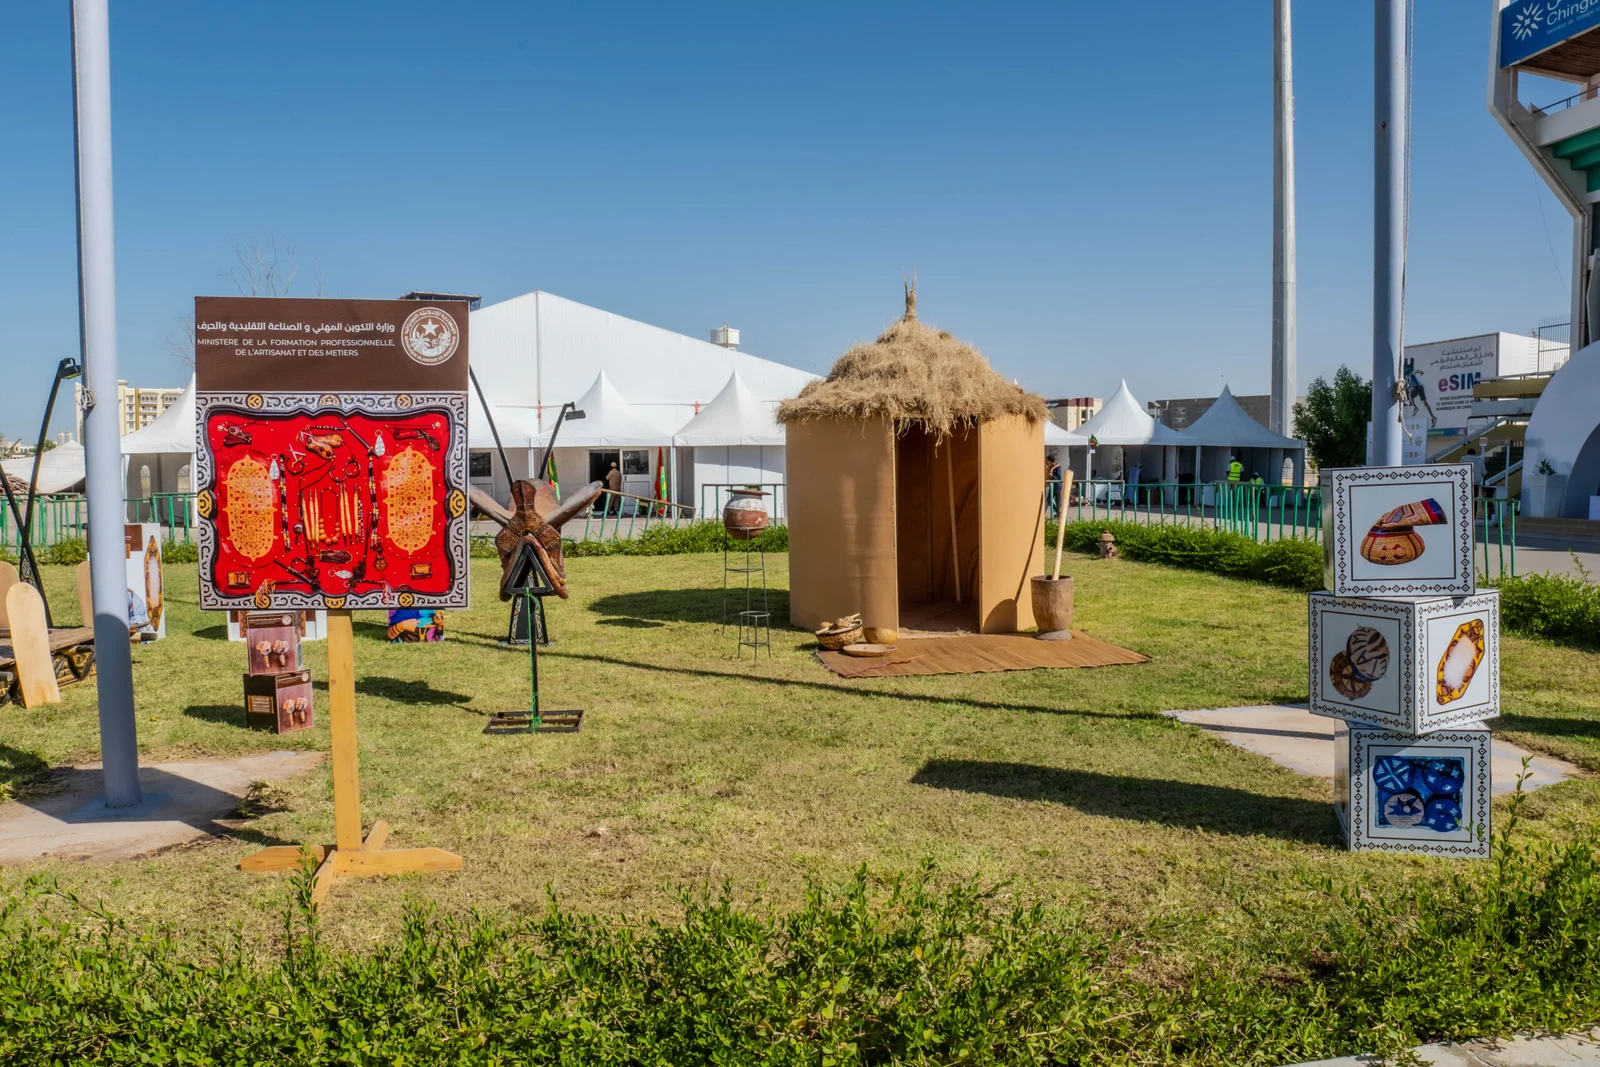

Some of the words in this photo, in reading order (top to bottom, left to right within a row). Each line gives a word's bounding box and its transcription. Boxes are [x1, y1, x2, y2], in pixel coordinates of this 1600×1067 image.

[197, 322, 227, 332] والحرف
[229, 322, 266, 332] التقليدية
[268, 322, 302, 331] الصناعة
[312, 323, 342, 335] المهني
[345, 323, 374, 333] التكوين
[376, 323, 395, 333] وزارة
[320, 339, 395, 347] PROFESSIONNELLE,
[1438, 372, 1481, 392] eSIM
